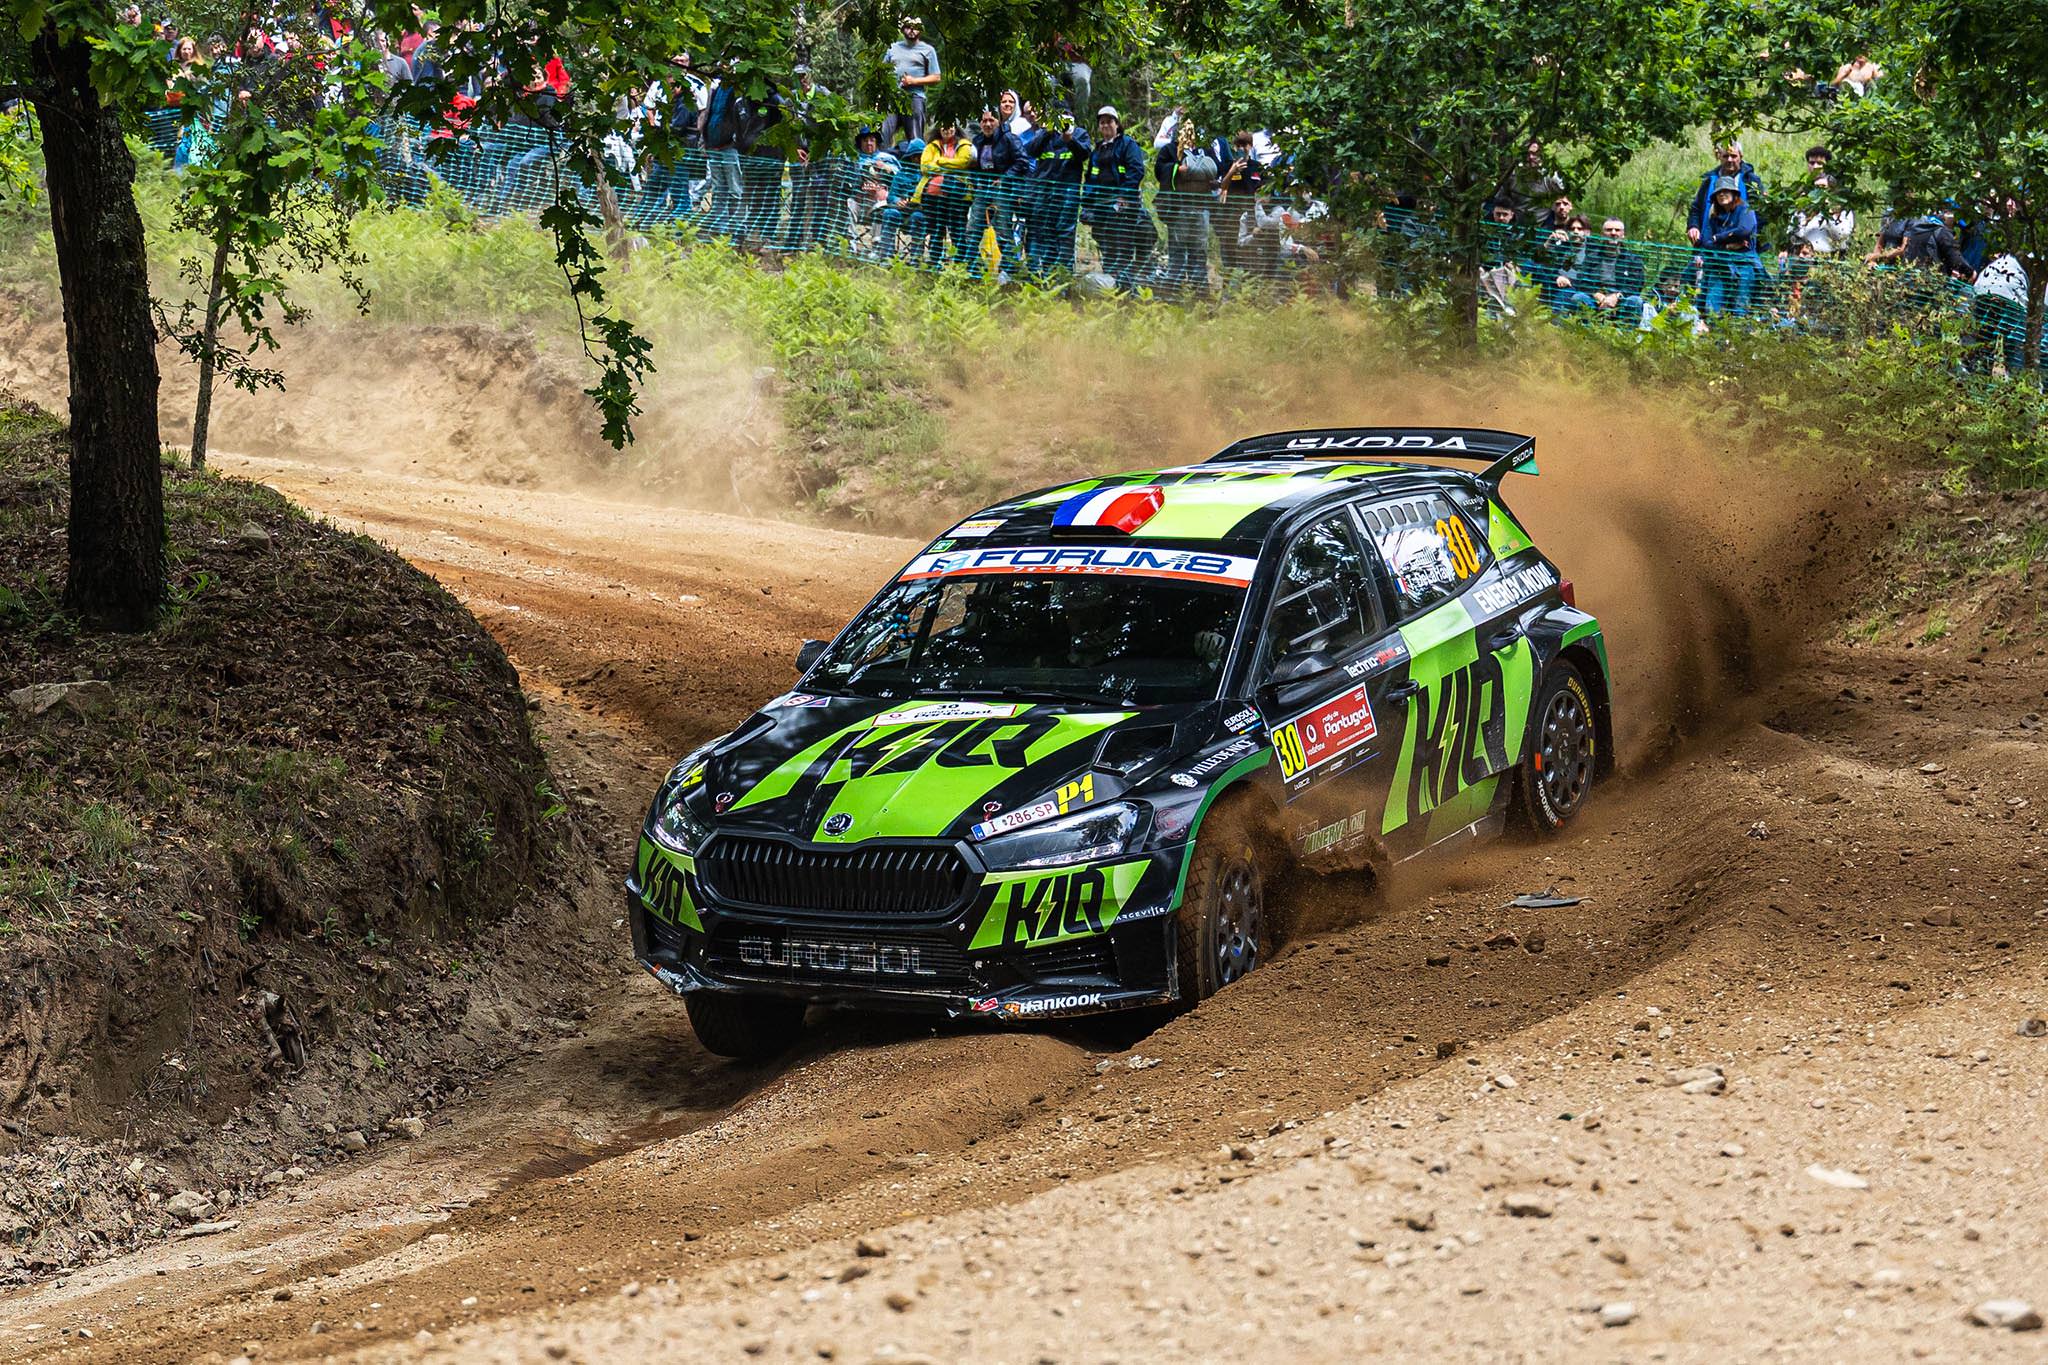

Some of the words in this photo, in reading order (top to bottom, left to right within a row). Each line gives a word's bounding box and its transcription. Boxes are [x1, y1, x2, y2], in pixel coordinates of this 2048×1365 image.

[973, 549, 1234, 574] FORUM8
[1435, 515, 1480, 579] 30
[1323, 703, 1370, 738] Portugal
[1188, 757, 1222, 776] VILLE
[1225, 739, 1256, 757] NICE
[1274, 723, 1305, 778] 30
[1055, 773, 1095, 815] P1
[1006, 803, 1053, 827] 286-SP
[739, 938, 937, 974] EUROSOL
